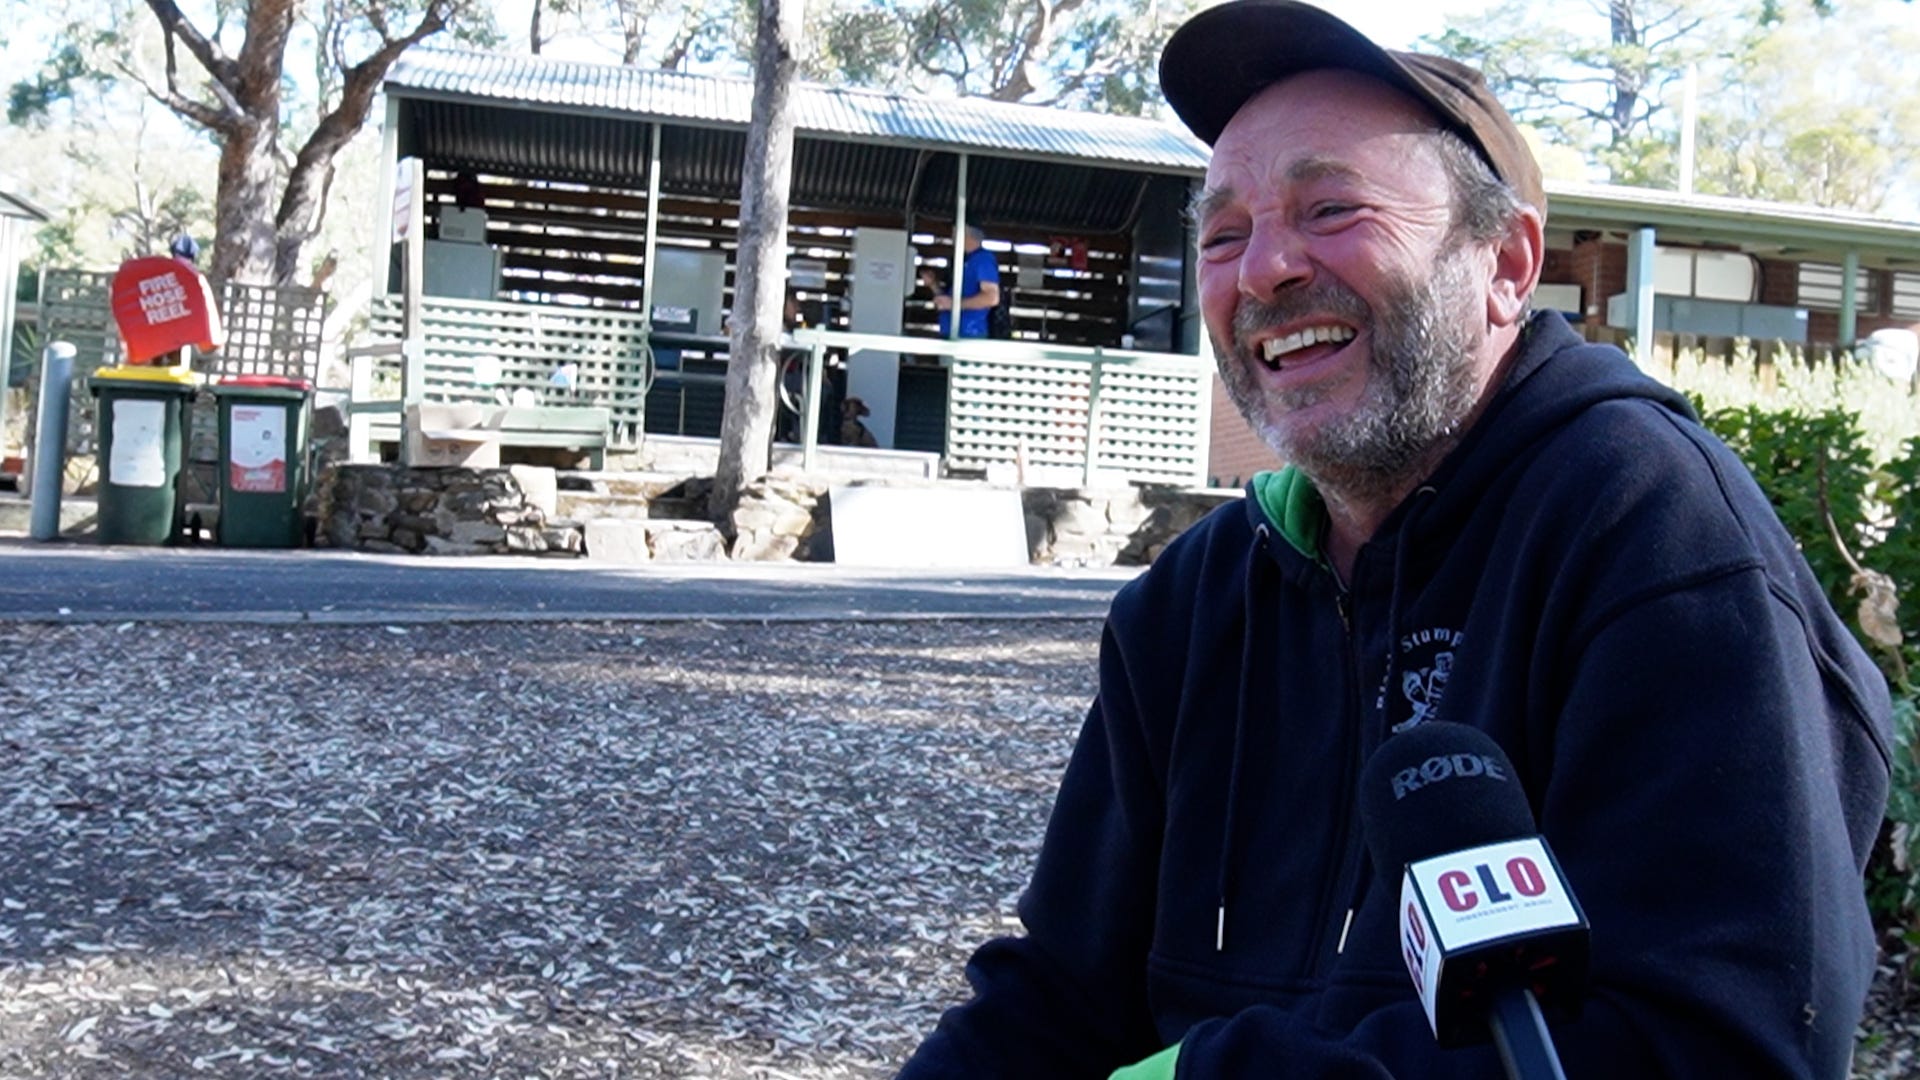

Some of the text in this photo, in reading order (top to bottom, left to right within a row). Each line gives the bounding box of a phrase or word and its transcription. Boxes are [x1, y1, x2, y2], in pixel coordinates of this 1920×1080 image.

[138, 271, 179, 296] FIRE
[139, 285, 188, 312] HOSE
[146, 302, 192, 325] REEL
[1437, 856, 1547, 912] CLO
